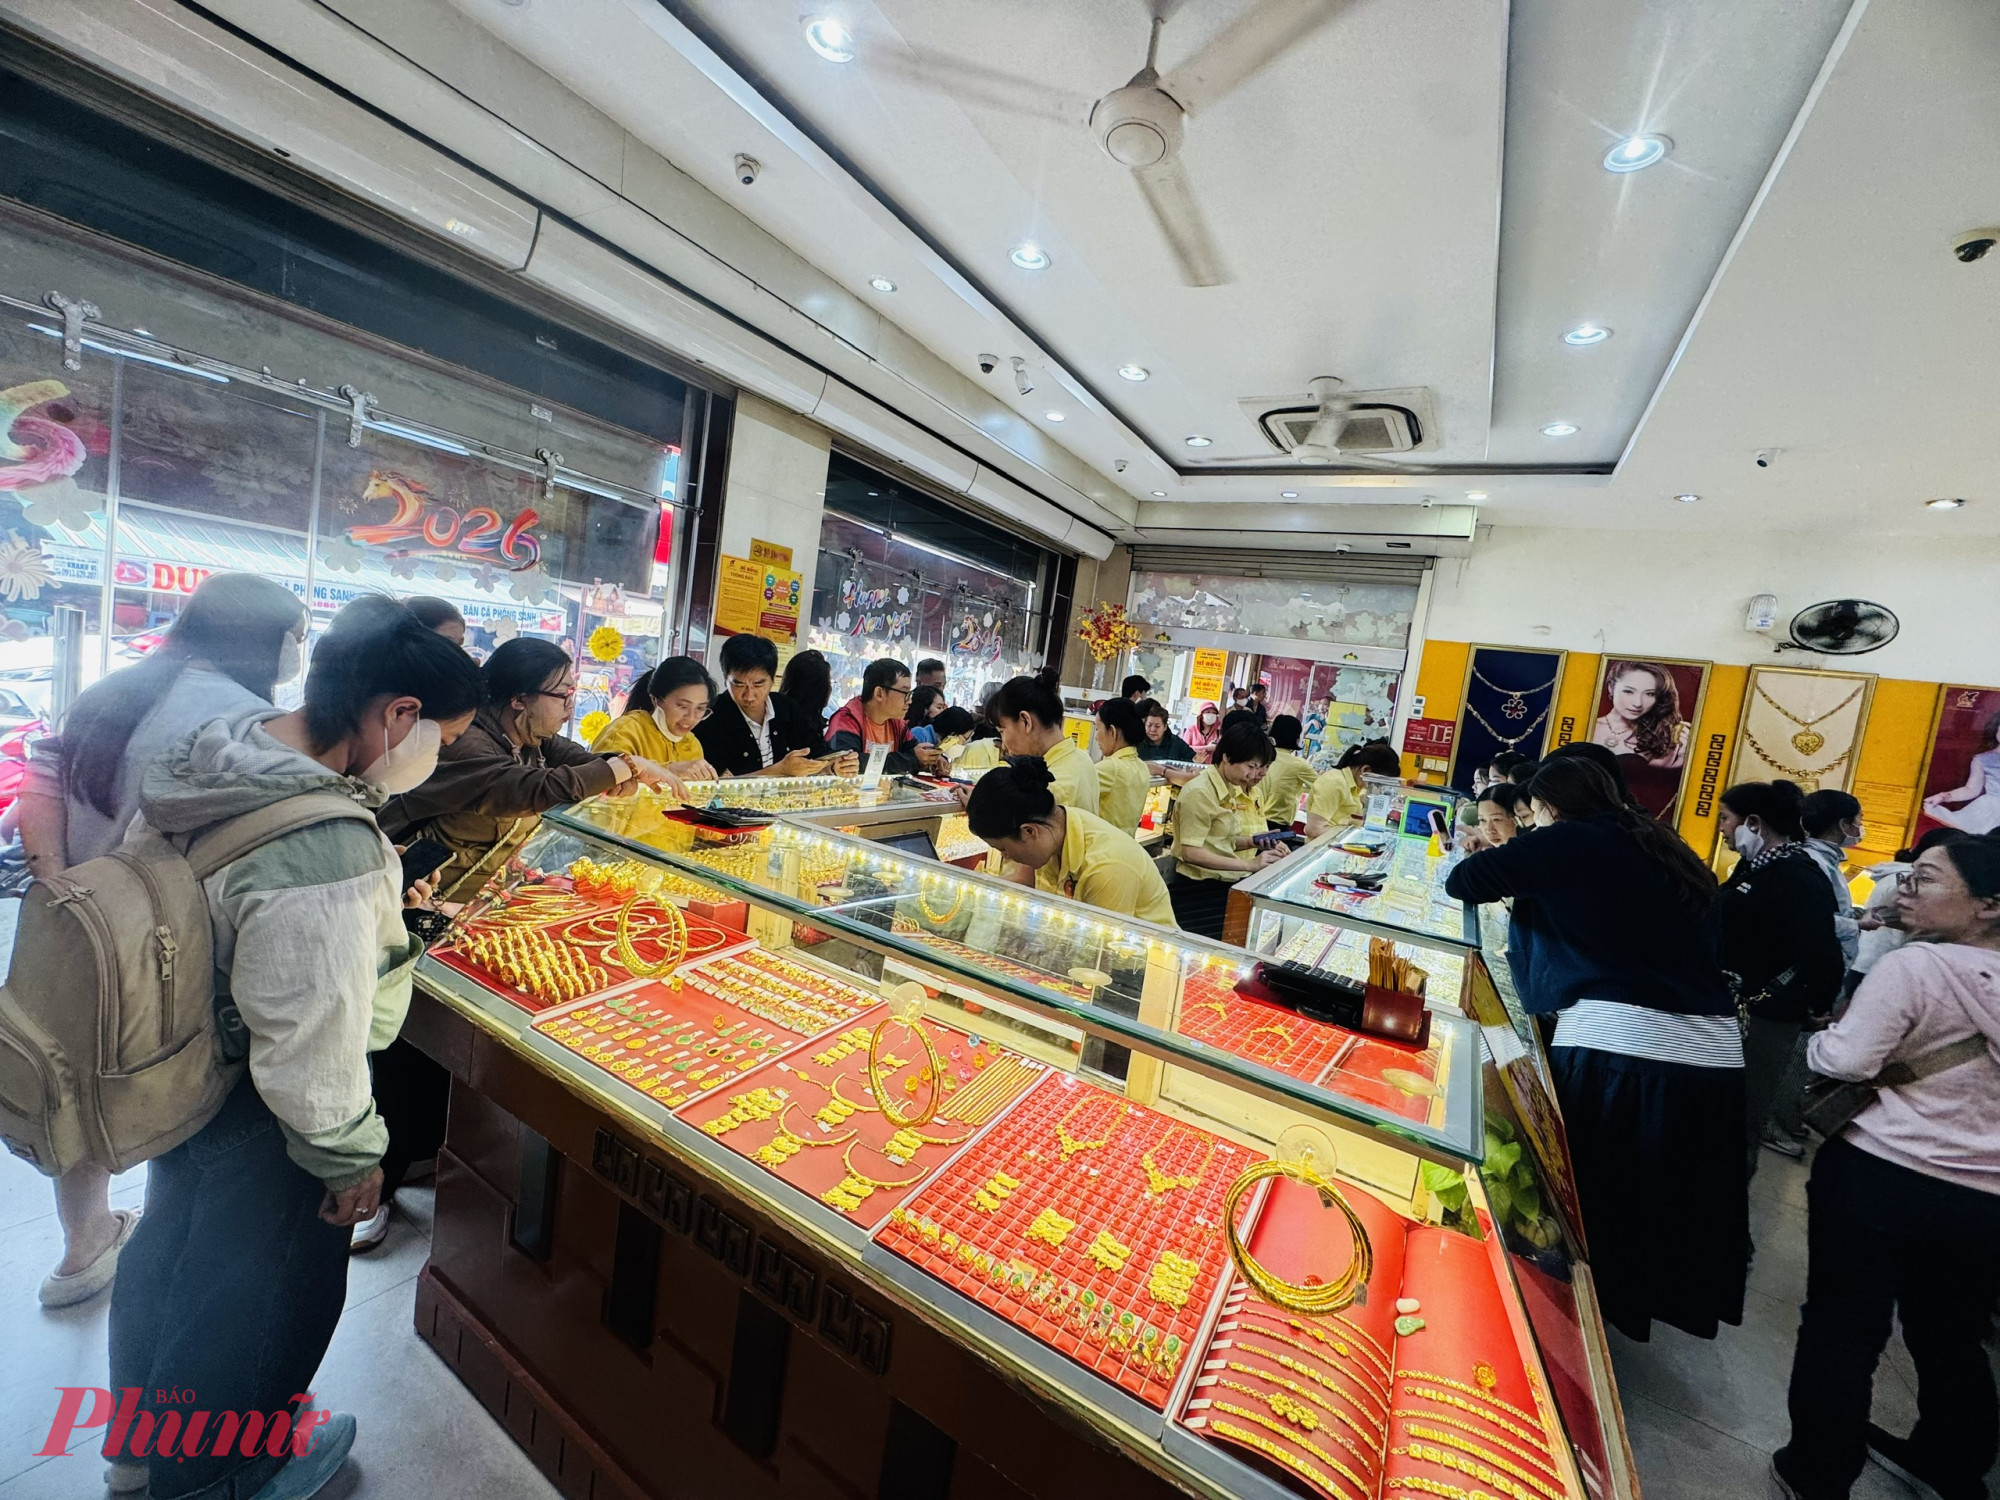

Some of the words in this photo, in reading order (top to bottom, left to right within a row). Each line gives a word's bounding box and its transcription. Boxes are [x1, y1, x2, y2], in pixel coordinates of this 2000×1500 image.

[344, 470, 541, 572] 2026
[843, 578, 891, 609] Happy
[850, 612, 886, 637] New
